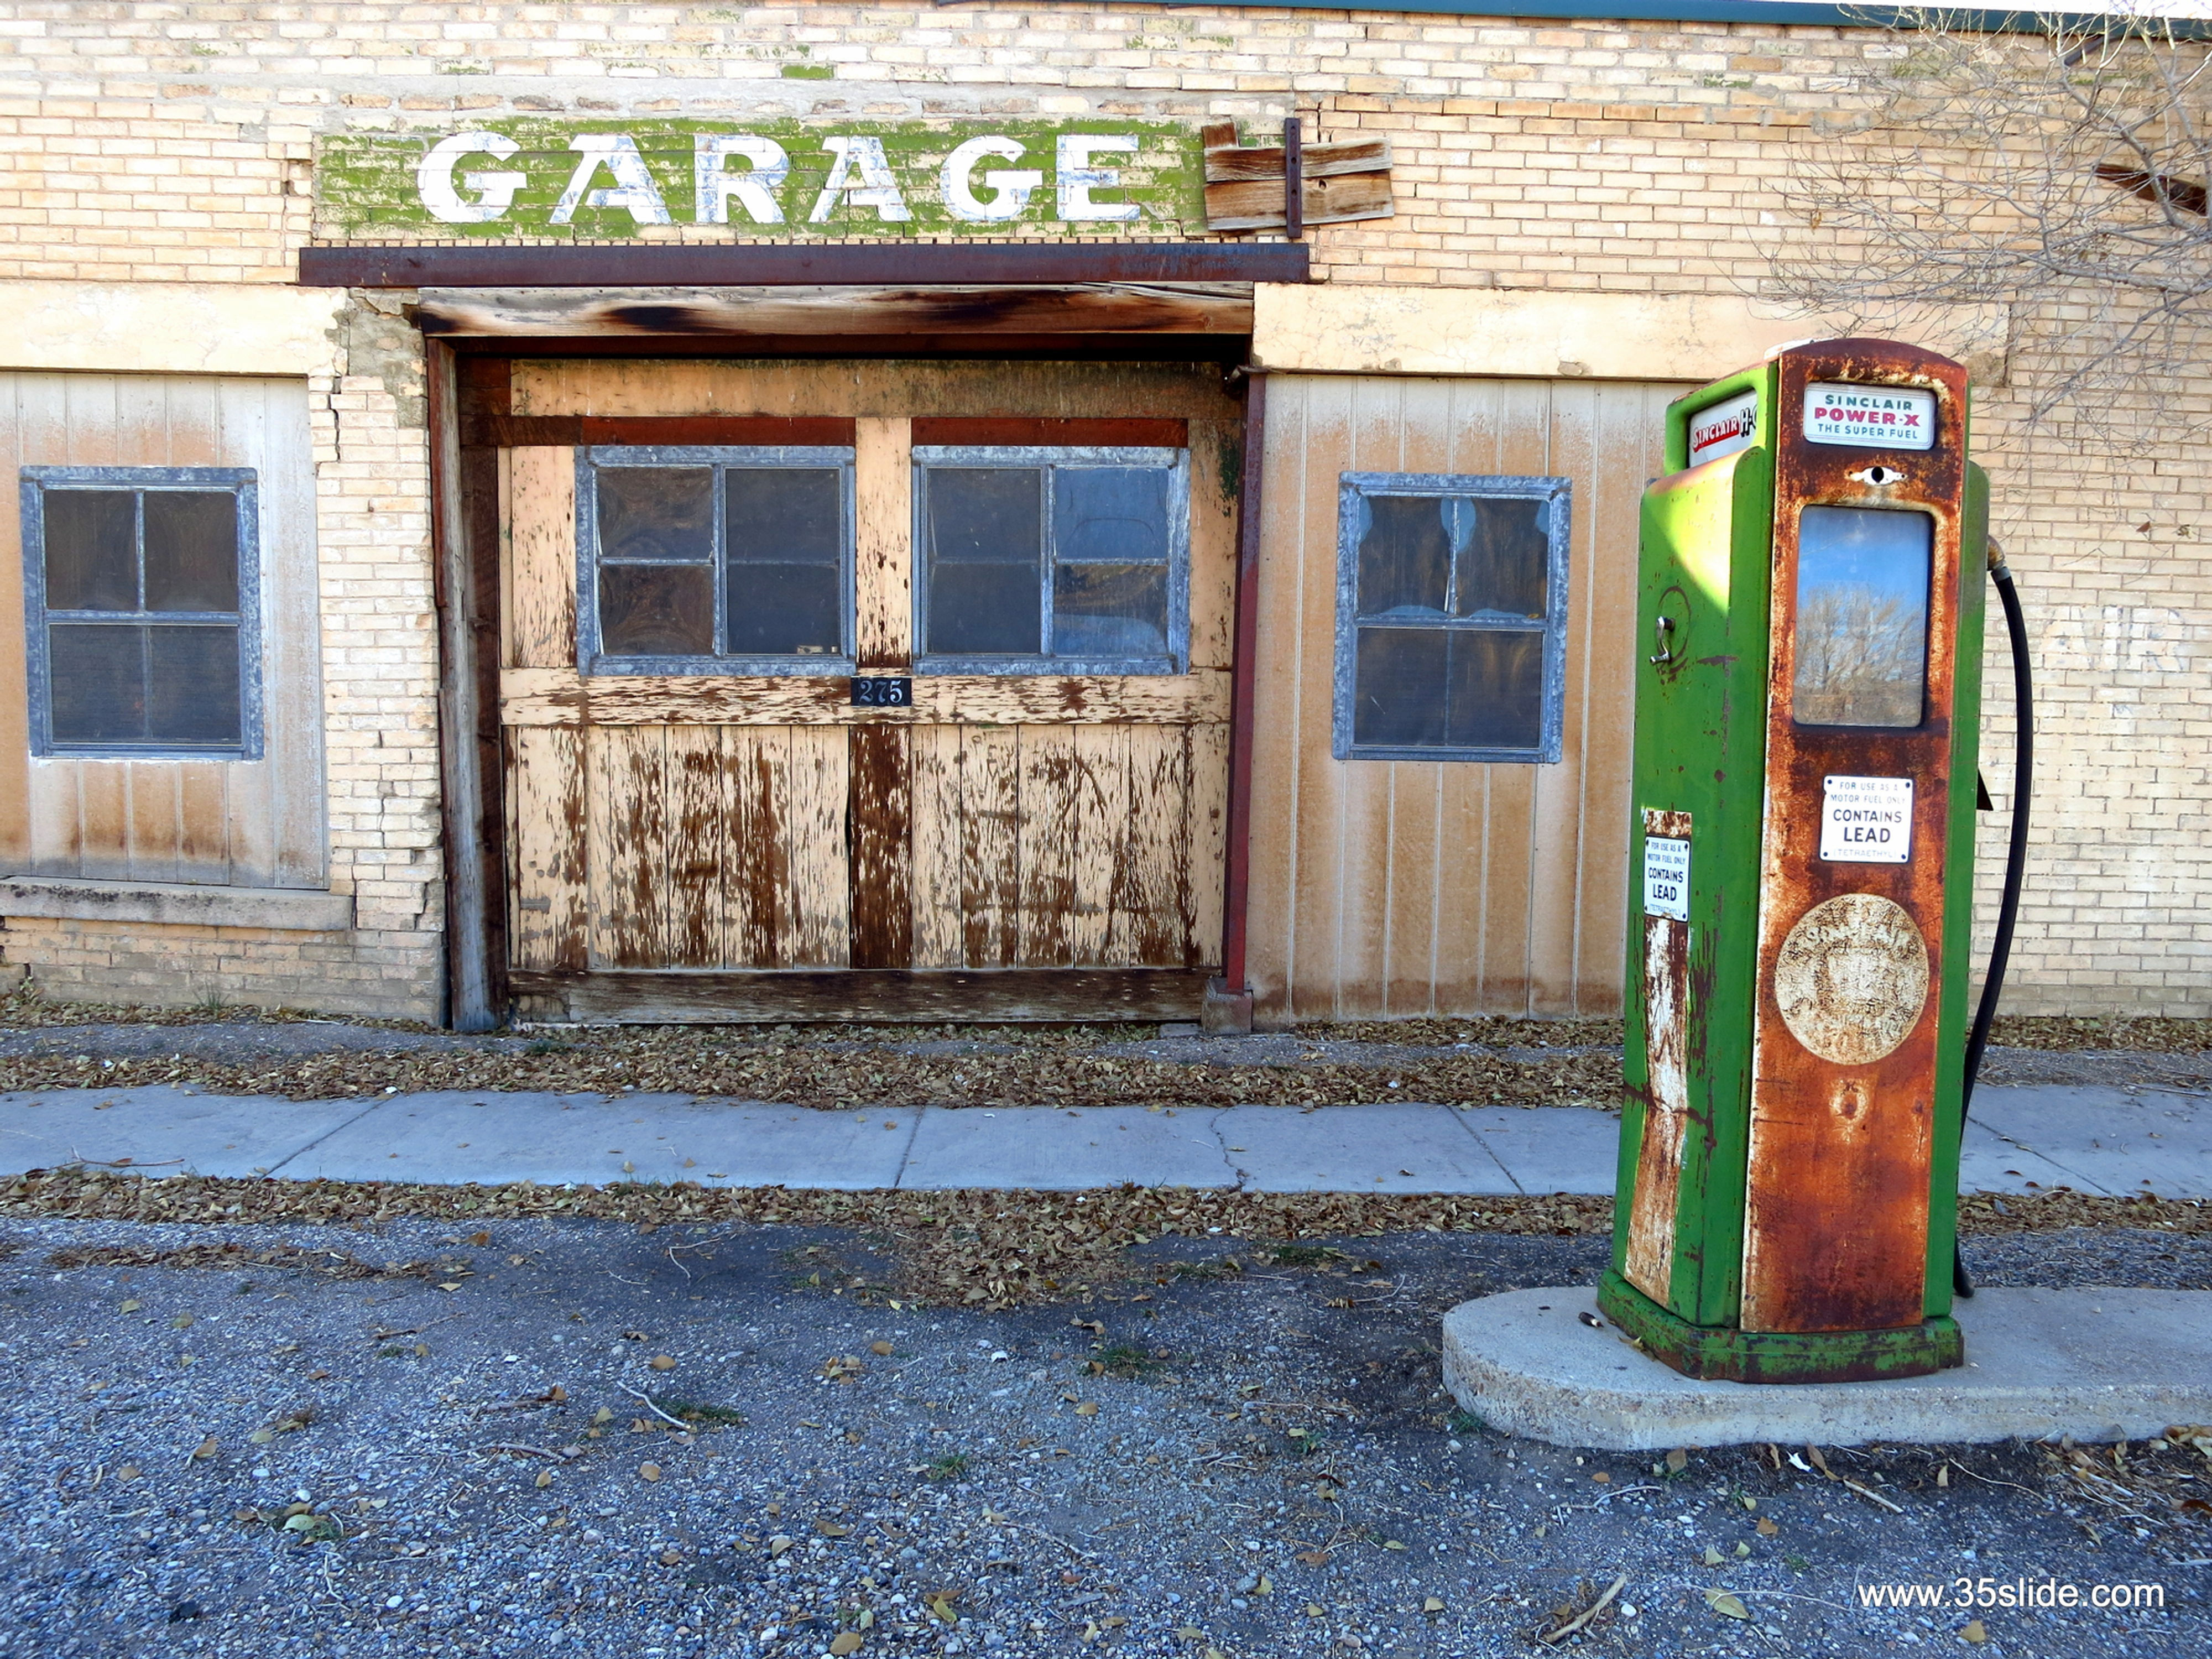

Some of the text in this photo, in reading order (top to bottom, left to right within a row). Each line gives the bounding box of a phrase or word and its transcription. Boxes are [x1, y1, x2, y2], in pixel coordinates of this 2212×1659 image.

[416, 130, 1142, 223] GARAGE
[1825, 394, 1912, 410] SINCLAIR
[1814, 407, 1920, 427] POWER-X
[1693, 416, 1739, 450] SINCLAIR
[1818, 424, 1918, 439] THE SUPER FUEL
[859, 680, 902, 703] 275
[1840, 781, 1856, 790] FOR
[1861, 782, 1876, 791] USE
[1880, 783, 1889, 791] AS
[1830, 794, 1906, 805] MOTOR FUEL ONLY
[1833, 808, 1902, 823] CONTAINS
[1844, 826, 1891, 843] LEAD
[1651, 842, 1660, 851] FOR
[1661, 843, 1669, 852] USE
[1670, 844, 1676, 852] AS
[1833, 848, 1897, 858] (TETRAETHYL)
[1662, 855, 1672, 864] FUEL
[1674, 857, 1686, 865] ONLY
[1648, 867, 1683, 883] CONTAINS
[1652, 883, 1677, 901] LEAD
